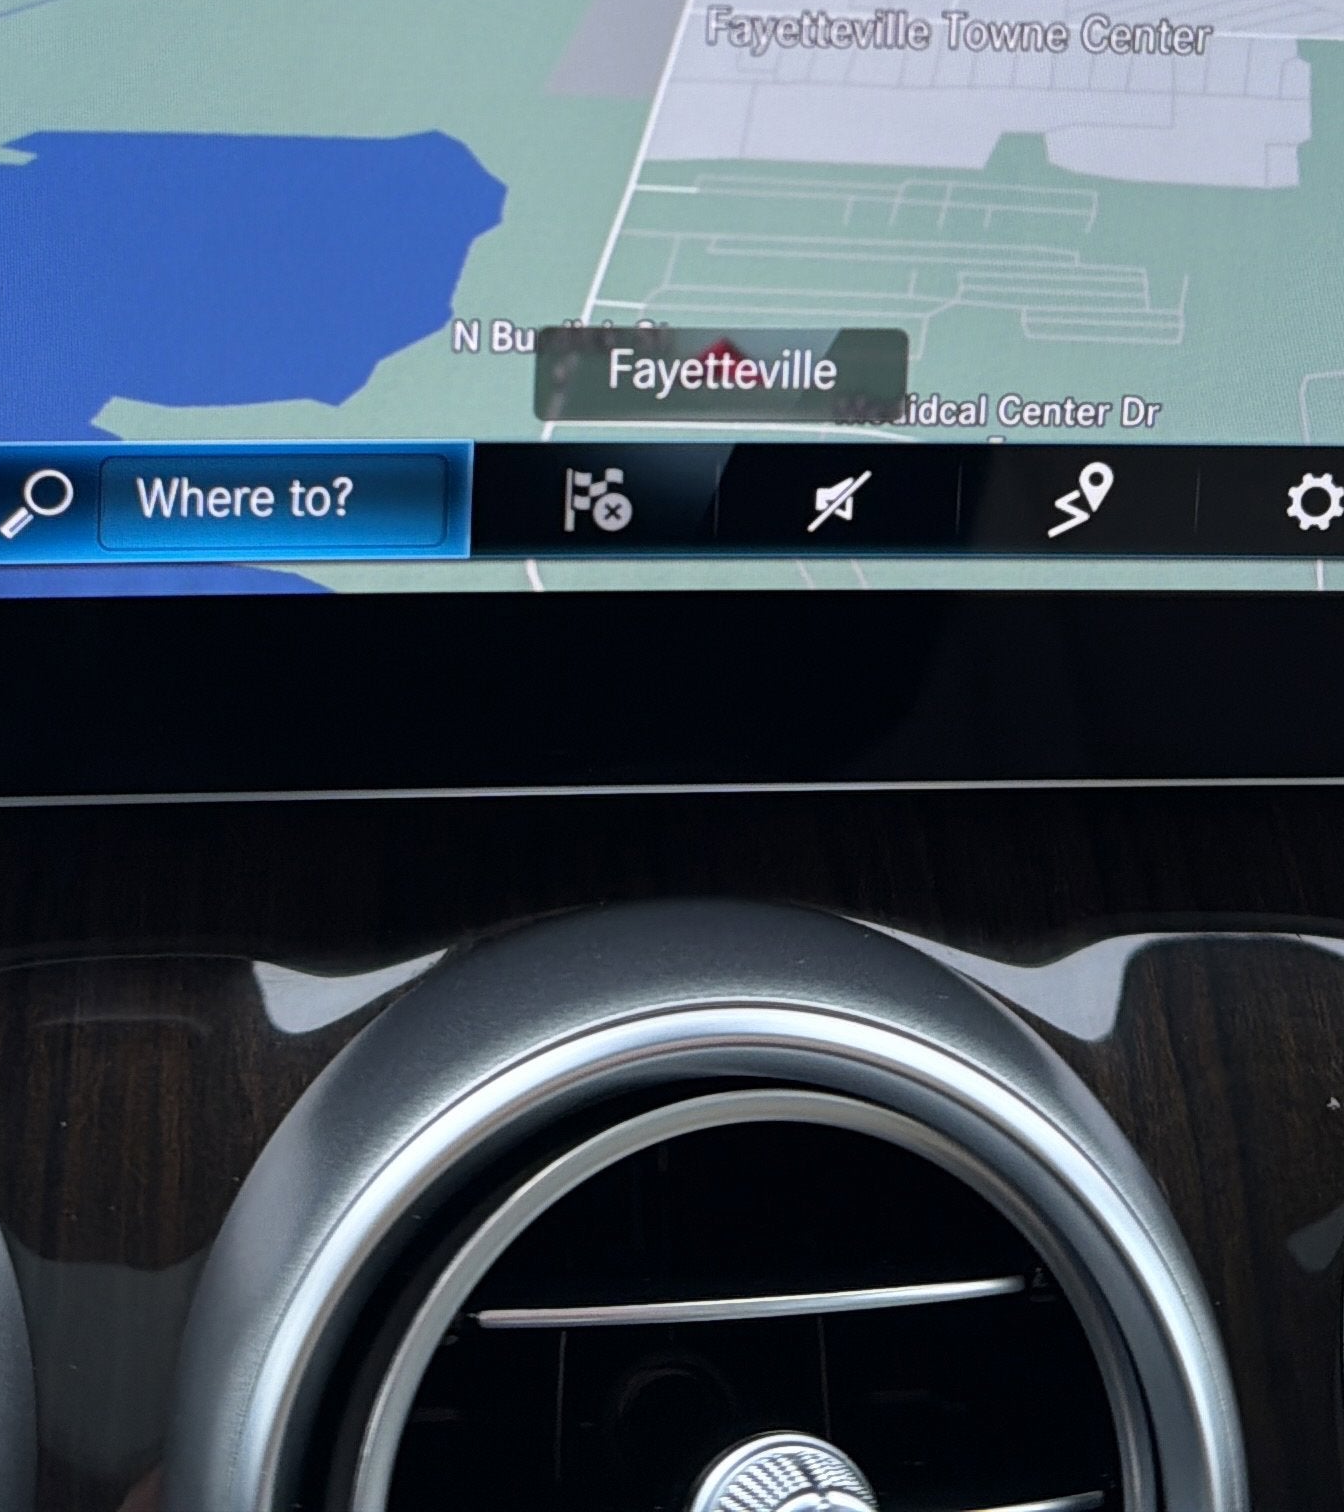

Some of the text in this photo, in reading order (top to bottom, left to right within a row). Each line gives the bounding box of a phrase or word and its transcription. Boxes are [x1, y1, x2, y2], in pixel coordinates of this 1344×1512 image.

[705, 6, 1213, 56] Fayetteville Towne Center
[452, 320, 479, 353] N
[608, 348, 838, 400] Fayetteville
[996, 393, 1112, 427] Center
[1120, 395, 1162, 428] Dr
[136, 476, 354, 519] Where to?
